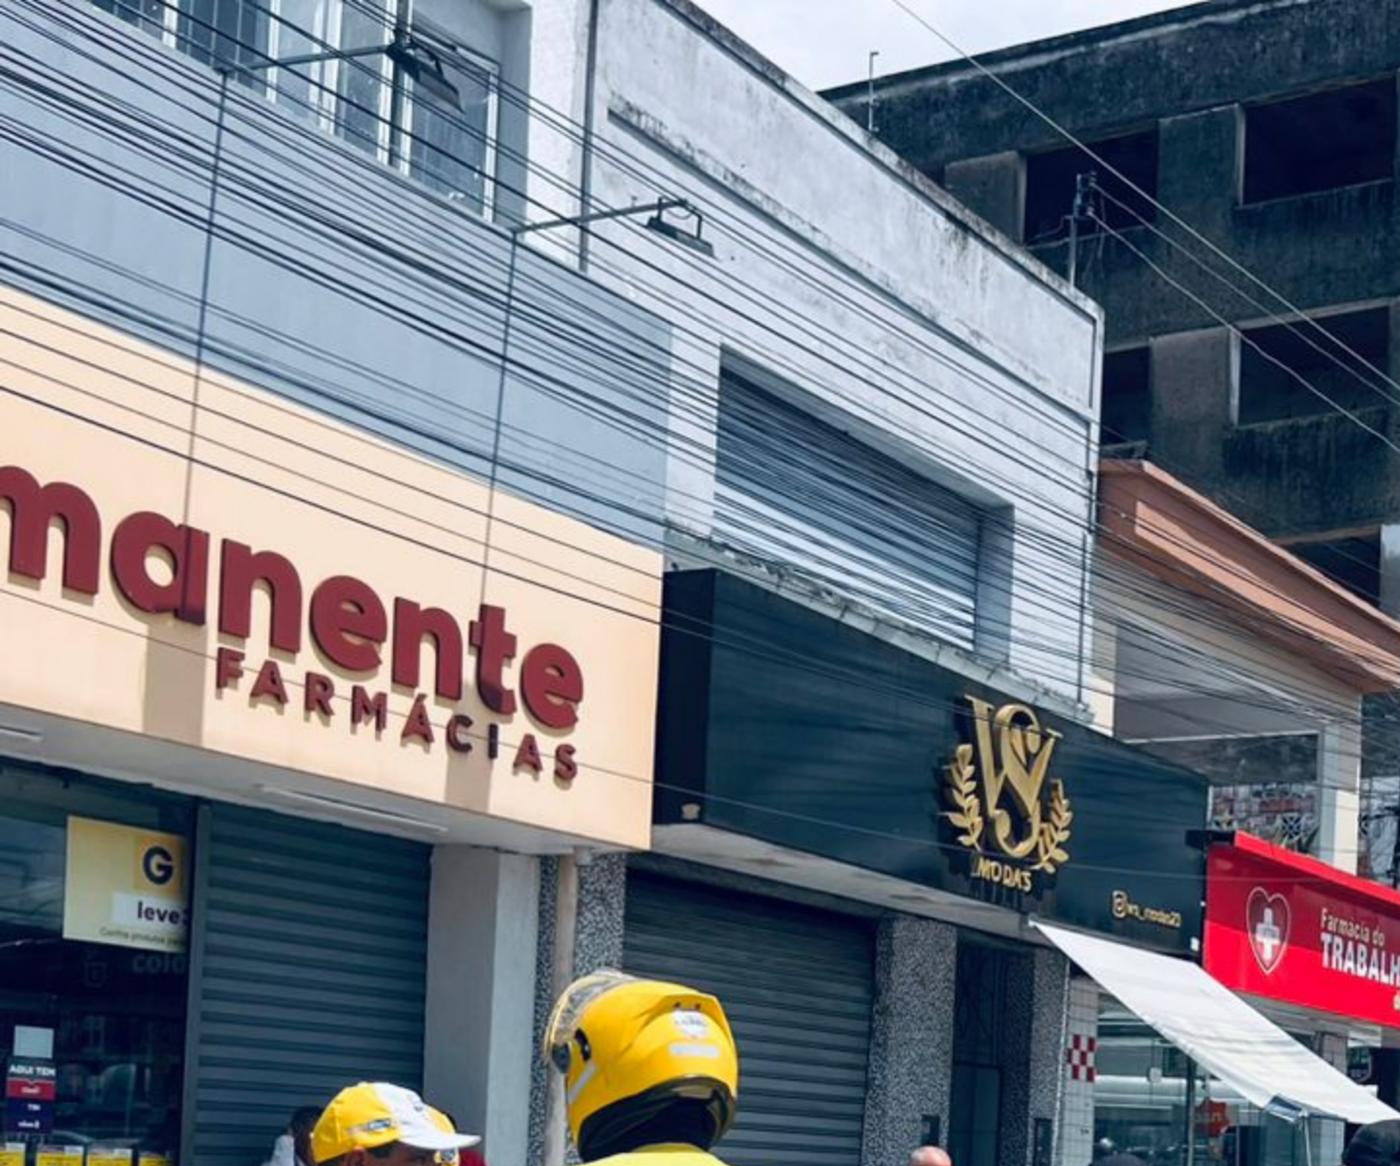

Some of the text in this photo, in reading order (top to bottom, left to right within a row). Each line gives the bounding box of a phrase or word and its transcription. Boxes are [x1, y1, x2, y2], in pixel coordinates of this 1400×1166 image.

[0, 466, 583, 728] manente
[216, 646, 577, 781] FARMÁCIAS
[143, 846, 173, 885] G
[971, 857, 1032, 892] MODAS
[1321, 908, 1385, 947] Farmácia do
